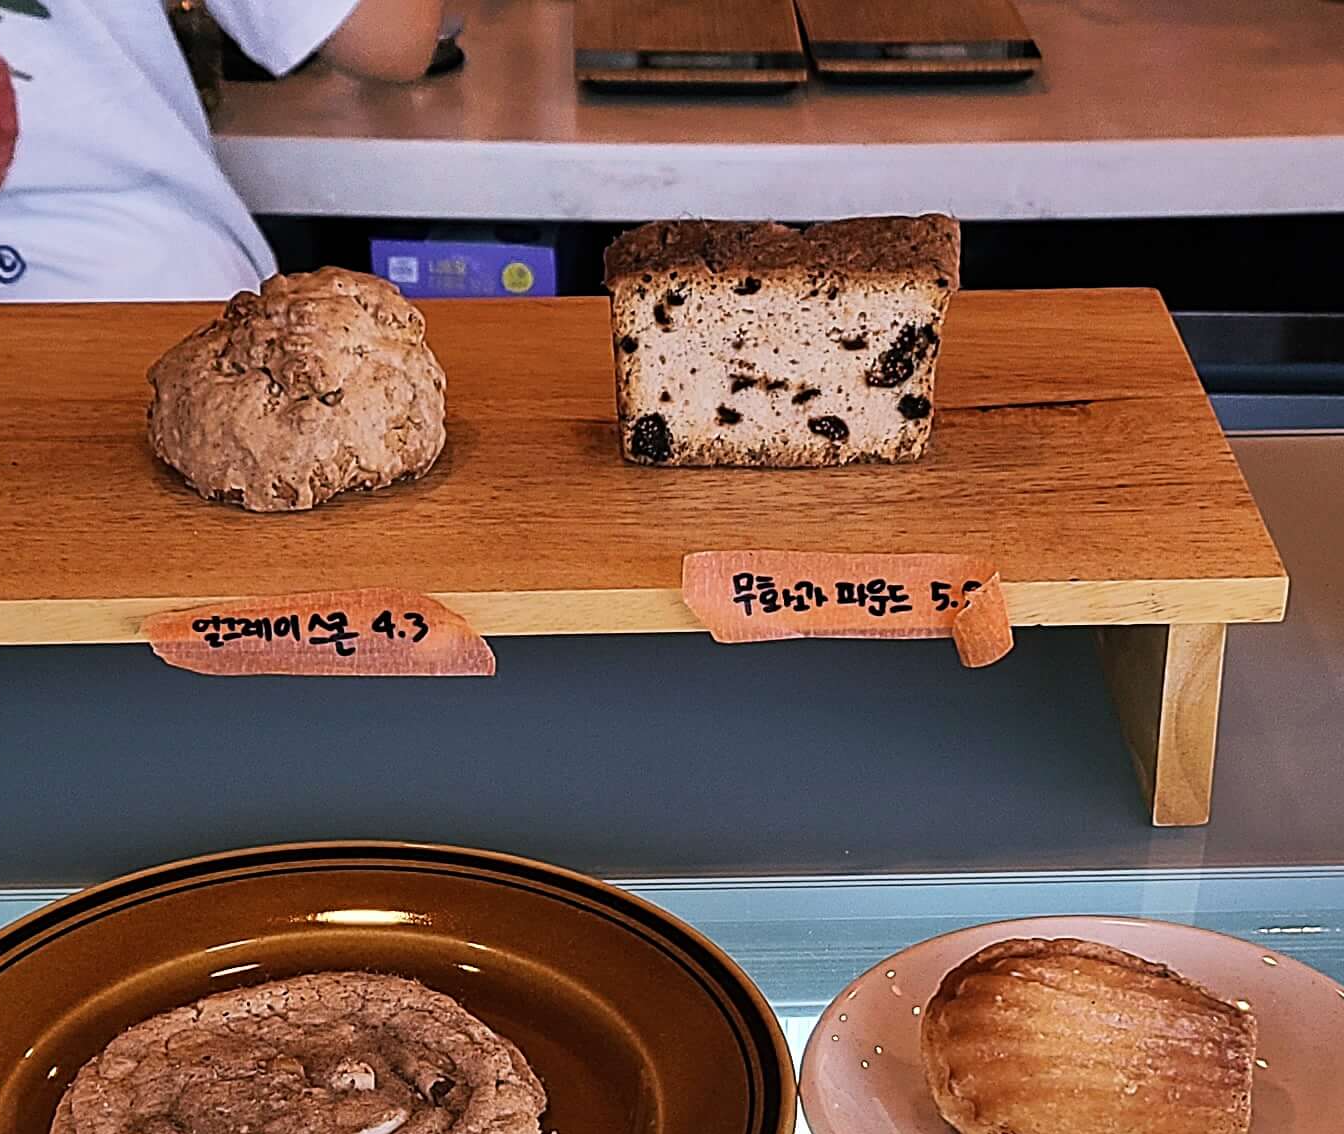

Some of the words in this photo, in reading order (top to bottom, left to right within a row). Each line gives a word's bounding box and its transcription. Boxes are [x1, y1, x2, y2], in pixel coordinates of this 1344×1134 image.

[733, 573, 828, 616] 무화과
[835, 579, 913, 616] 파운드
[192, 614, 301, 647] 얼그레이
[307, 611, 360, 656] 스콘
[371, 609, 430, 643] 4.3
